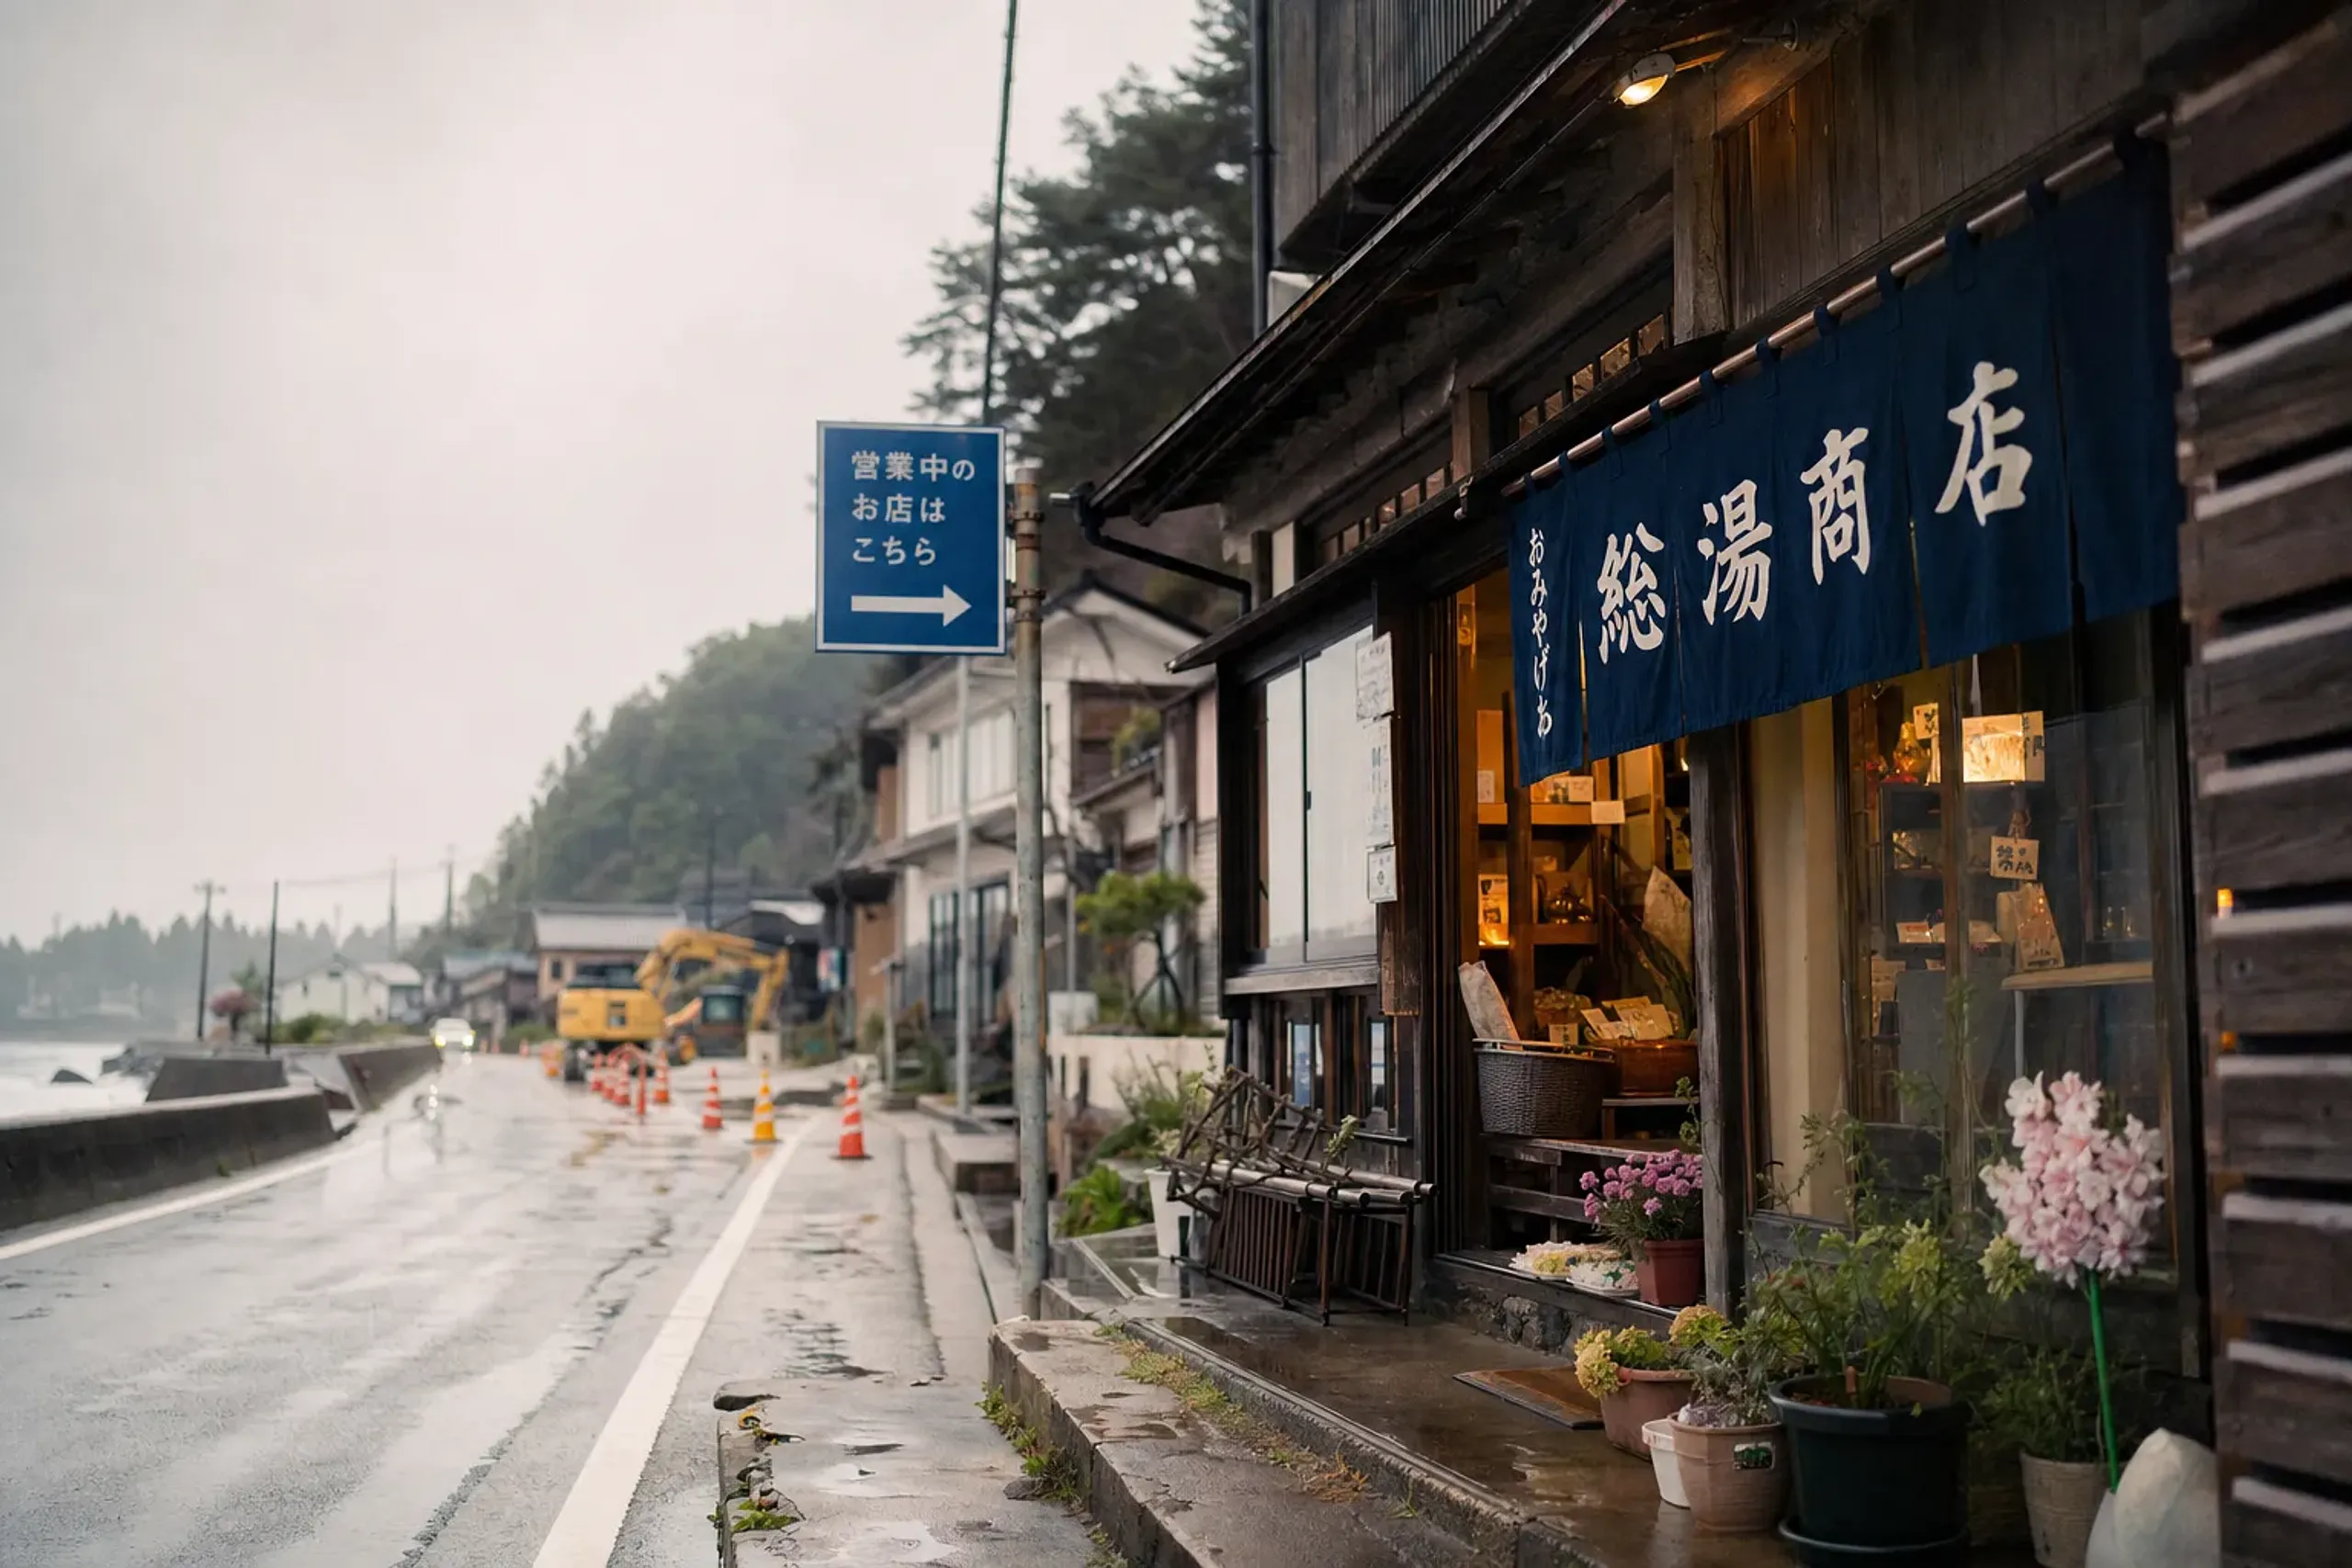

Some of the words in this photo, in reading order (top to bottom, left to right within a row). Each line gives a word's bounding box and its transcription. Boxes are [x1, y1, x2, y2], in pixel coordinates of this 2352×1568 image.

[851, 450, 976, 481] 営業中の
[852, 493, 945, 524] お店は
[1597, 362, 2033, 663] 総湯商店
[853, 536, 935, 565] こちら
